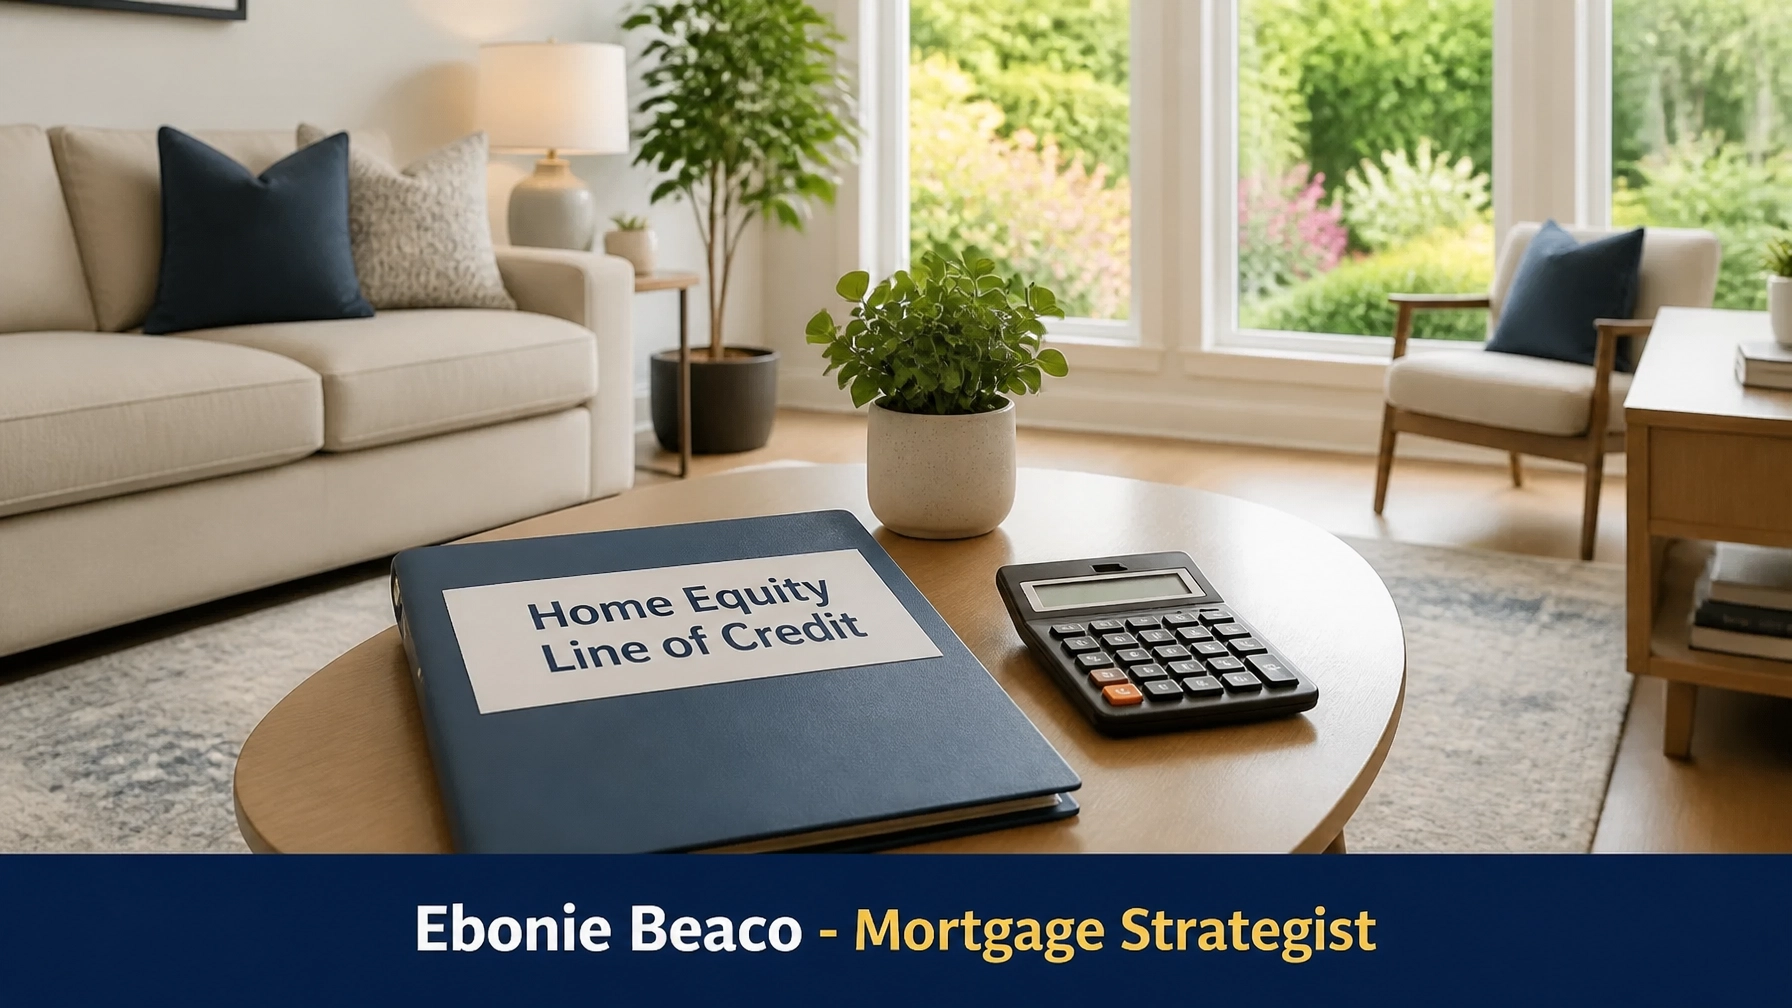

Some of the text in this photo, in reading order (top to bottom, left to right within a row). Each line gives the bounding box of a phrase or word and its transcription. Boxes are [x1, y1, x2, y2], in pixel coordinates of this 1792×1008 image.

[527, 577, 829, 631] Home Equity
[541, 612, 869, 673] Line of Credit
